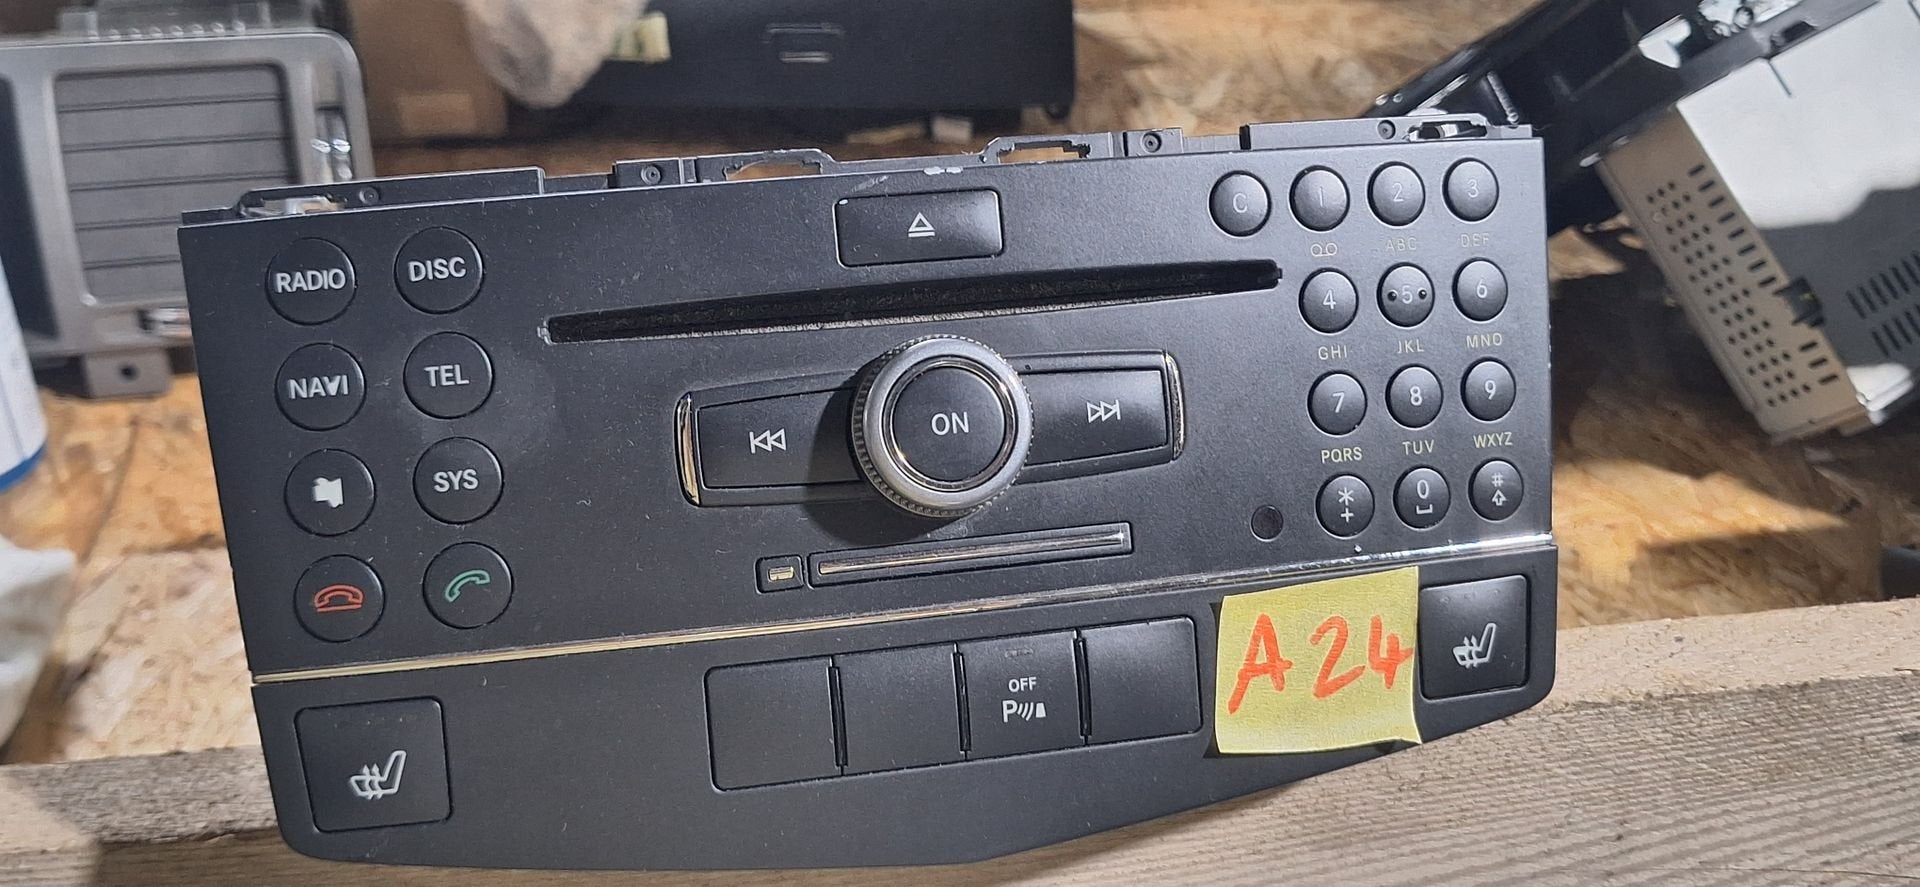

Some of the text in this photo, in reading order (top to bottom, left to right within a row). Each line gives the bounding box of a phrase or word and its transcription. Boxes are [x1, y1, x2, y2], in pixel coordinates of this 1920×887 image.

[1392, 182, 1404, 202] 2
[1467, 178, 1480, 198] 3
[1232, 192, 1248, 214] C
[1385, 236, 1417, 251] ABC
[1460, 232, 1491, 248] DEF
[407, 256, 467, 282] DISC
[274, 268, 346, 293] RADIO
[1476, 279, 1488, 298] 6
[1322, 289, 1337, 310] 4
[1401, 285, 1413, 304] 5
[1397, 339, 1425, 354] JKL
[1466, 332, 1503, 348] MNO
[1318, 344, 1348, 360] GHI
[424, 363, 470, 387] TEL
[287, 374, 349, 400] NAVI
[1409, 386, 1423, 406] 8
[1484, 379, 1497, 400] 9
[1333, 392, 1345, 413] 7
[931, 411, 969, 436] ON
[1402, 439, 1435, 456] TUV
[1473, 431, 1513, 449] WXYZ
[1321, 446, 1363, 464] PQRS
[433, 468, 479, 493] SYS
[1008, 676, 1037, 692] OFF
